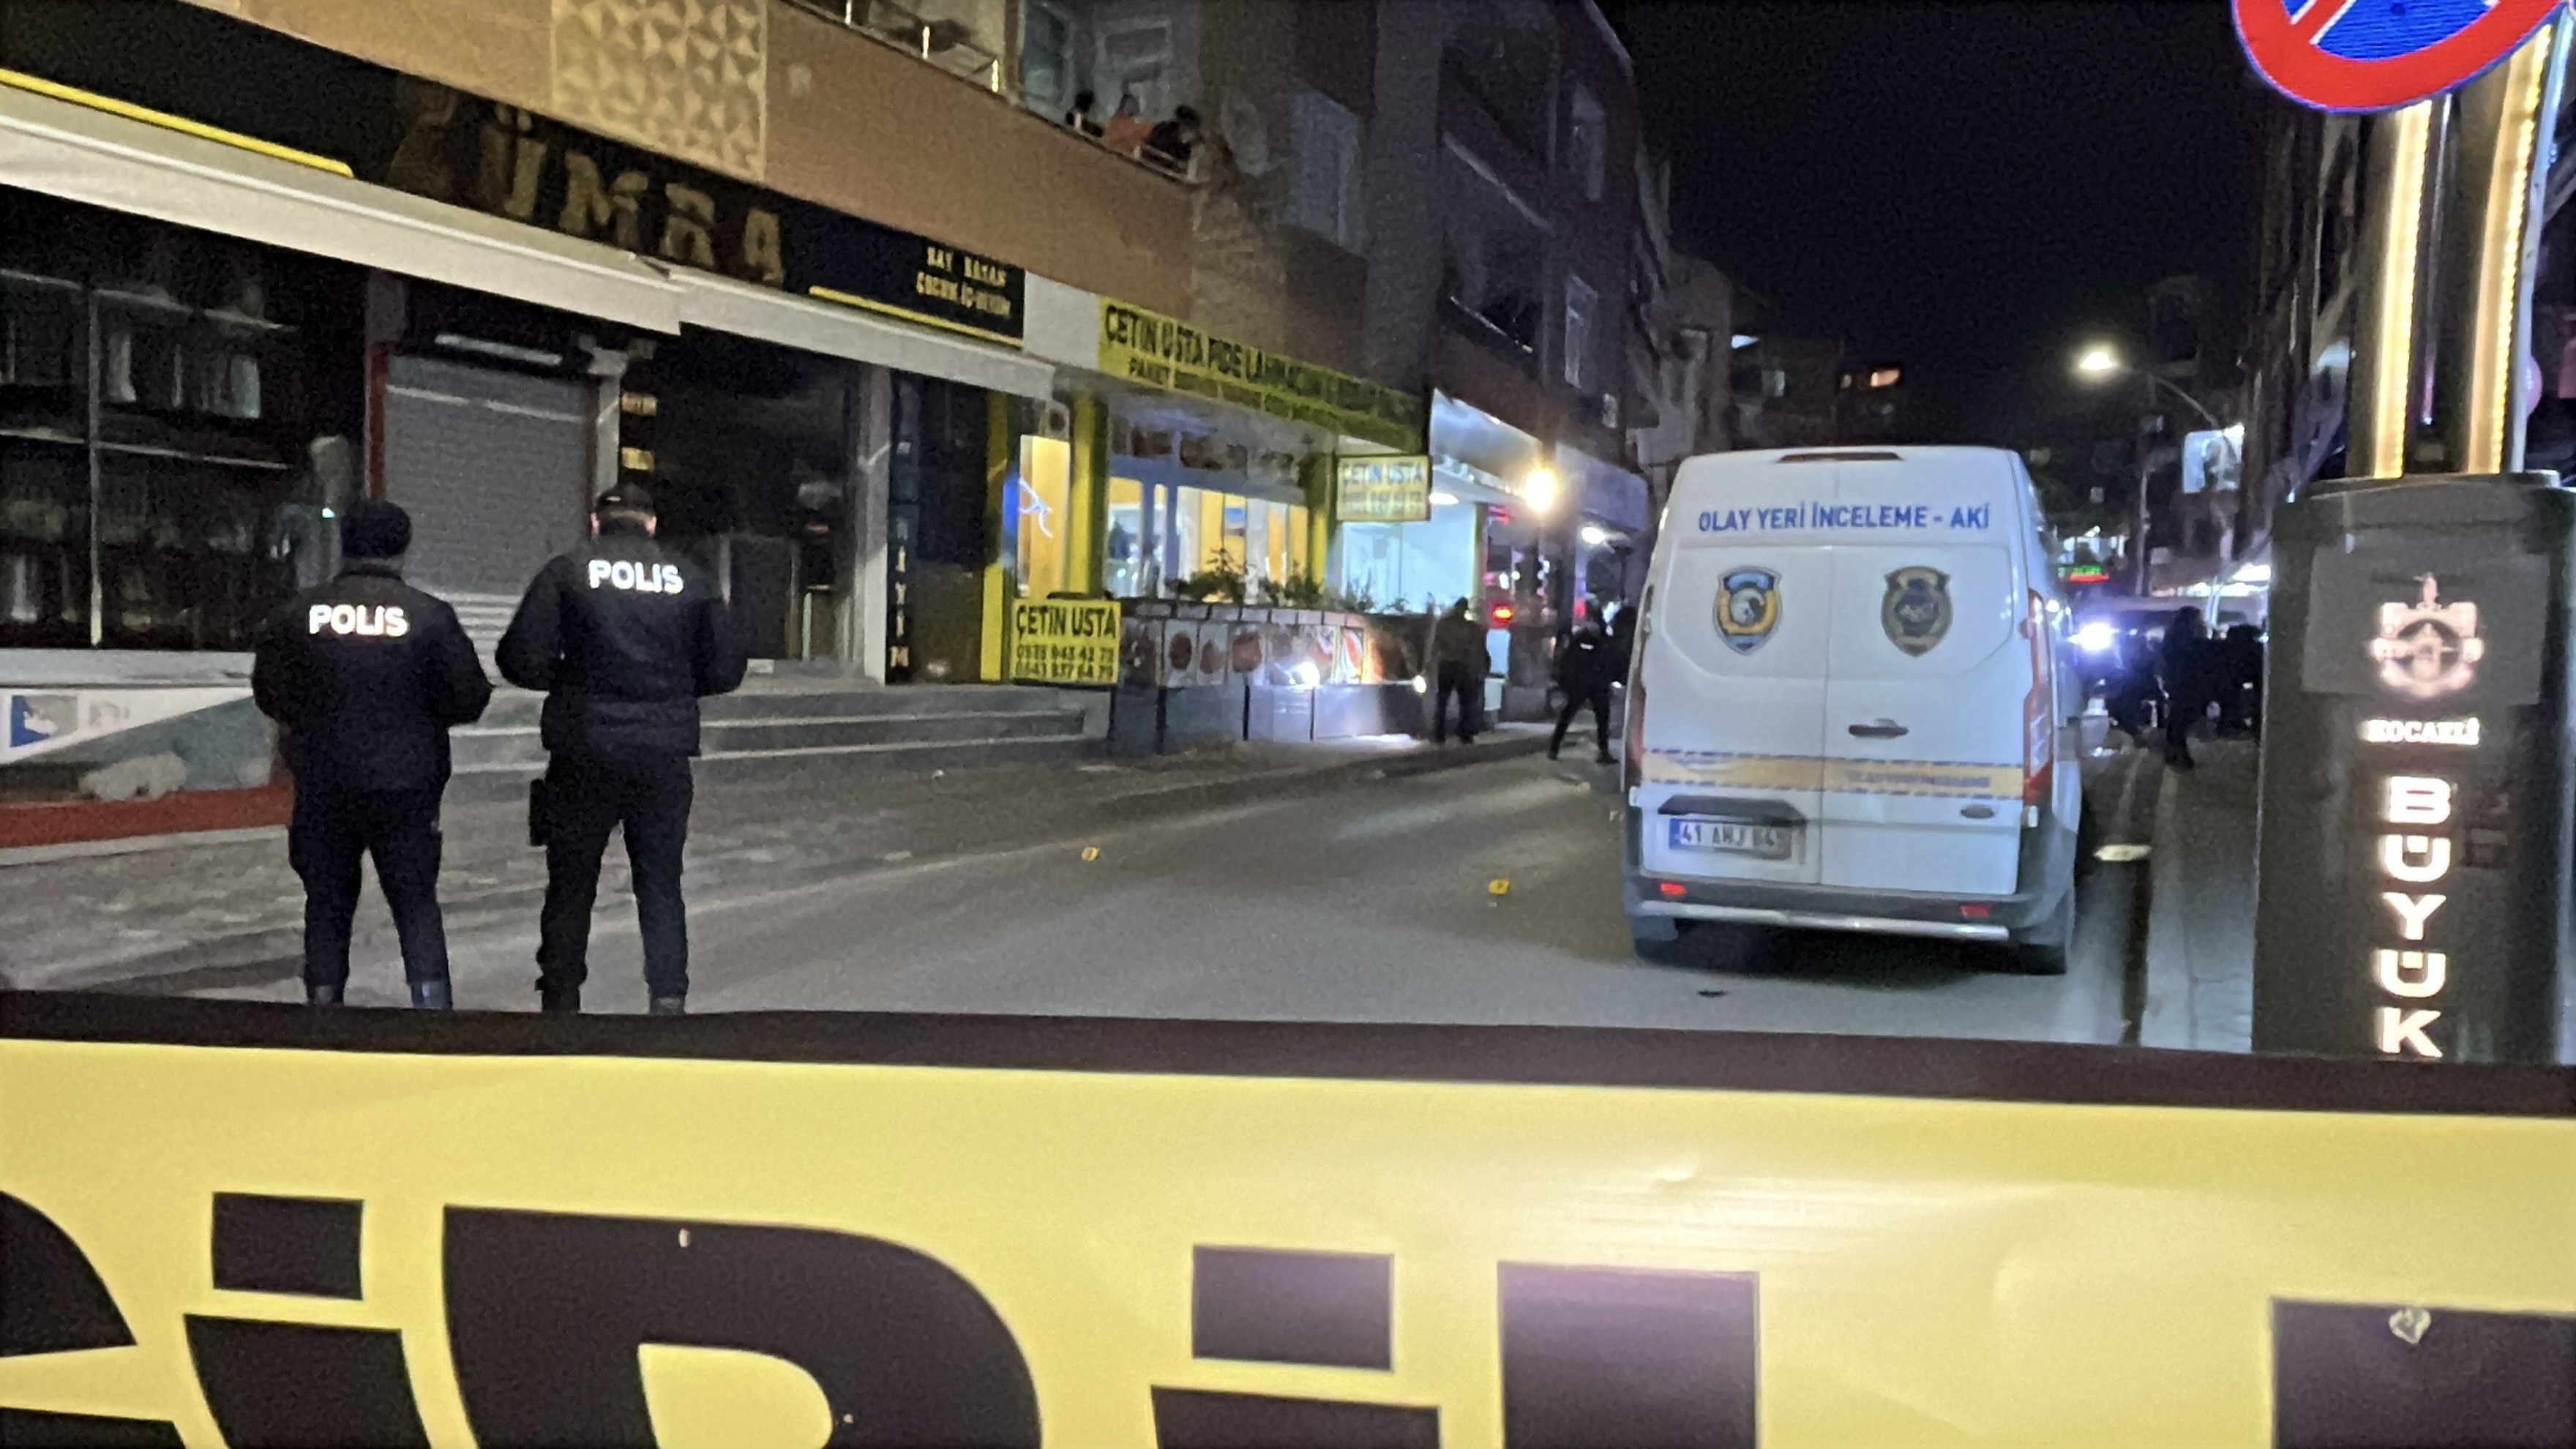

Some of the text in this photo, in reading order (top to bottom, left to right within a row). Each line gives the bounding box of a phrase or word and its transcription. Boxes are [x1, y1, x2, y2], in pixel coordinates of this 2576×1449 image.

[1699, 507, 1751, 531] OLAY
[1758, 502, 1805, 530] YERİ
[1812, 501, 1928, 528] İNCELEME
[1950, 502, 1991, 530] AKİ
[1072, 606, 1116, 639] USTA
[1682, 823, 1701, 842] 41
[2378, 776, 2452, 1058] BÜYÜK
